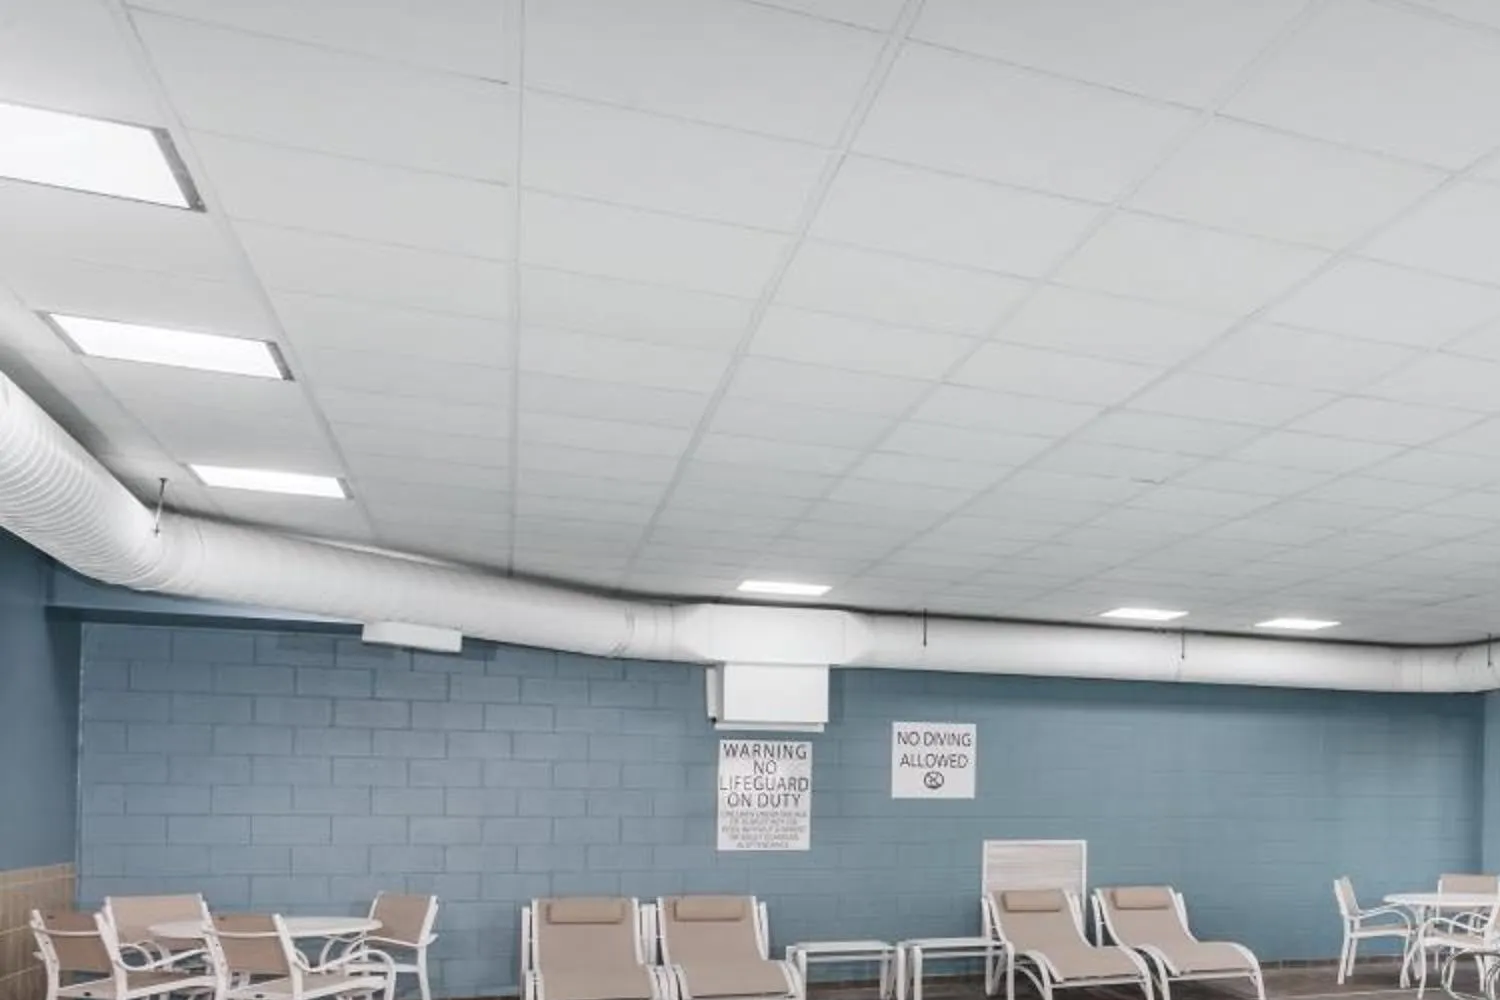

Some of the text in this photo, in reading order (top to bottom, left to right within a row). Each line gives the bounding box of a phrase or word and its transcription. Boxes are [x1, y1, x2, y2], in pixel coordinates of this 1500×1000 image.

[897, 731, 972, 747] NO DIVING
[723, 743, 807, 760] WARNING
[753, 759, 777, 775] NO
[900, 753, 968, 769] ALLOWED
[719, 775, 809, 792] LIFEGUARD
[727, 791, 801, 808] ON DUTY
